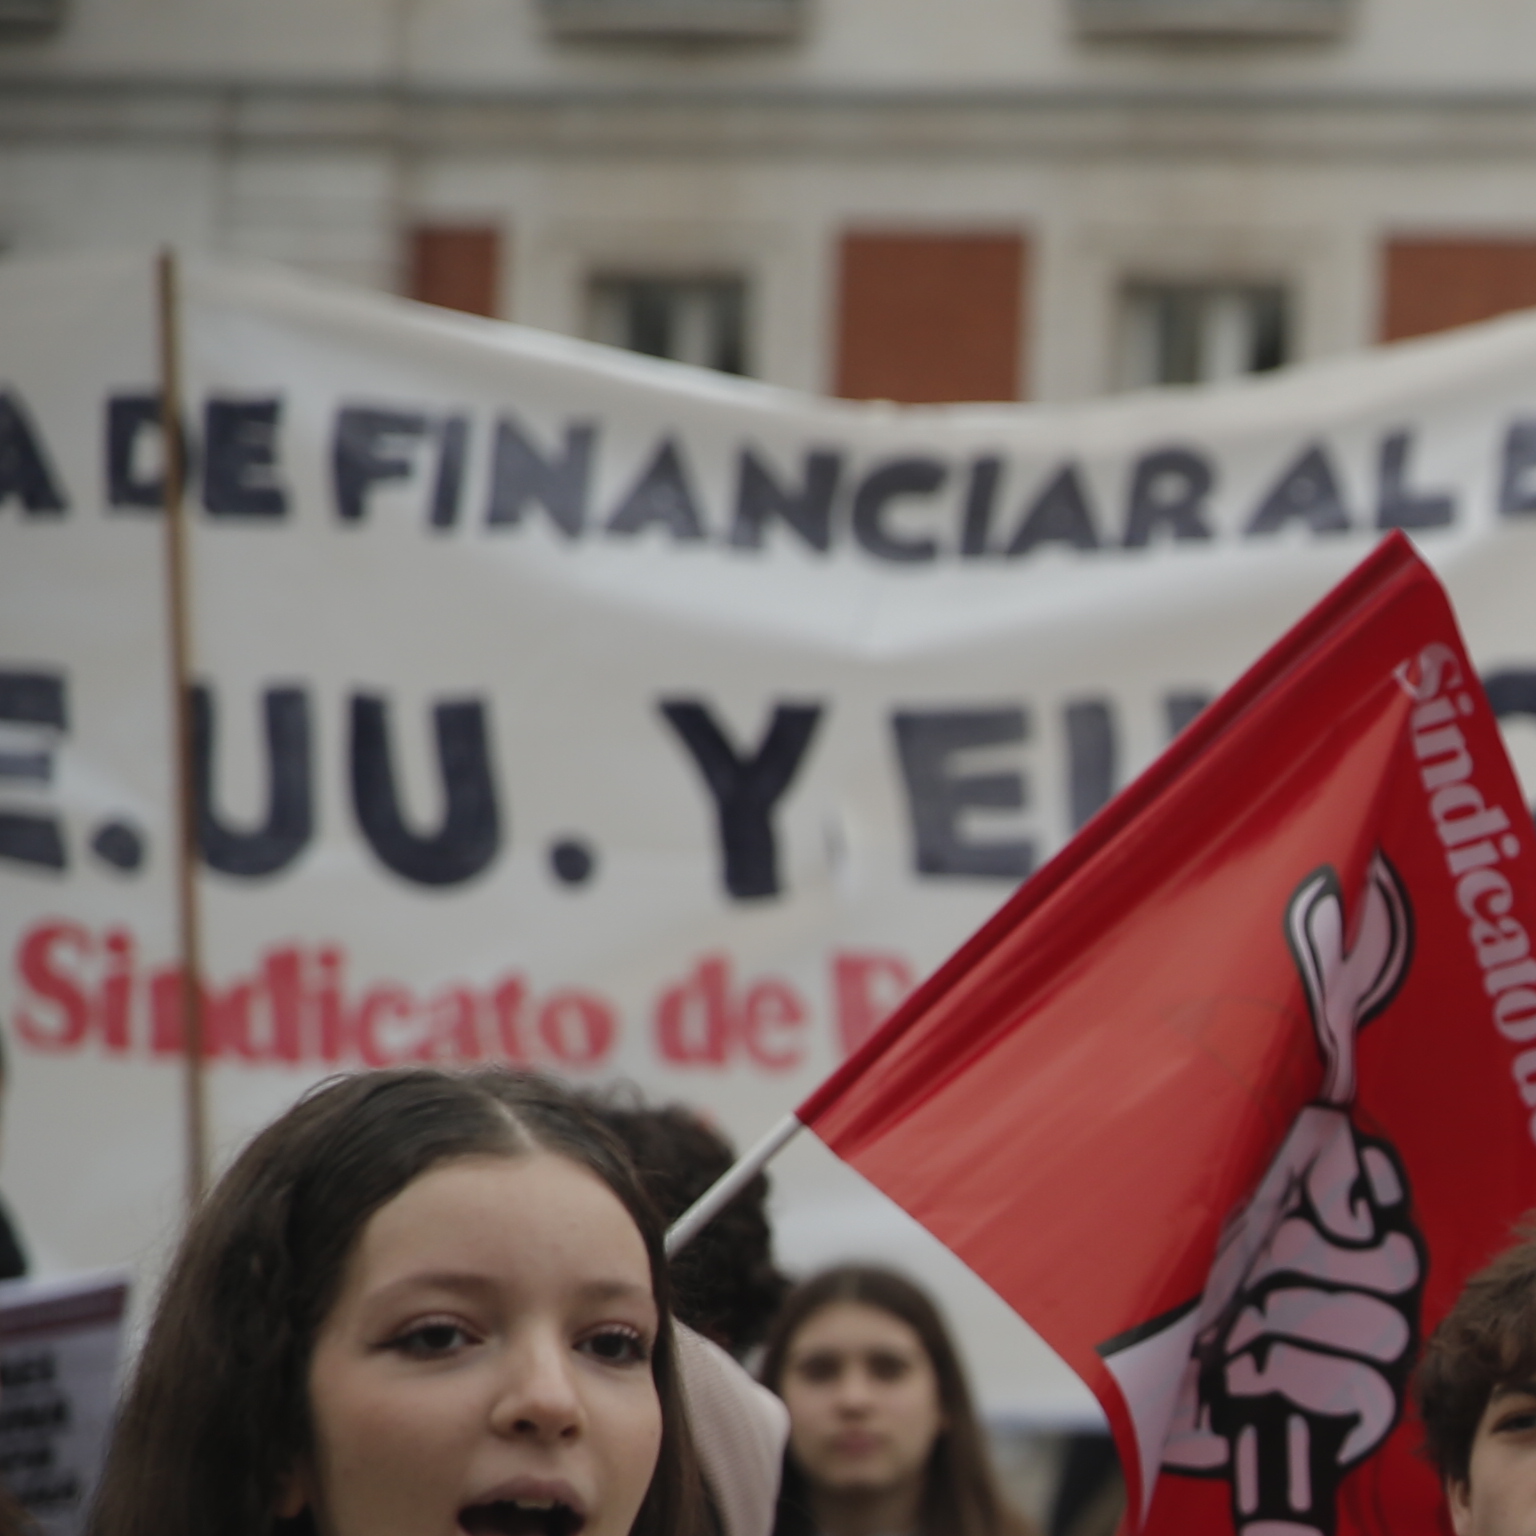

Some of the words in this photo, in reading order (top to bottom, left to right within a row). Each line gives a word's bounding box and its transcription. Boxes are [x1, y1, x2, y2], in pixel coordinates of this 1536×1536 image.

[105, 391, 291, 519] DE
[332, 405, 1215, 562] FINANCIAR
[1243, 430, 1455, 542] AL
[656, 696, 824, 903] Y
[15, 915, 617, 1071] Sindicato
[655, 952, 806, 1071] de
